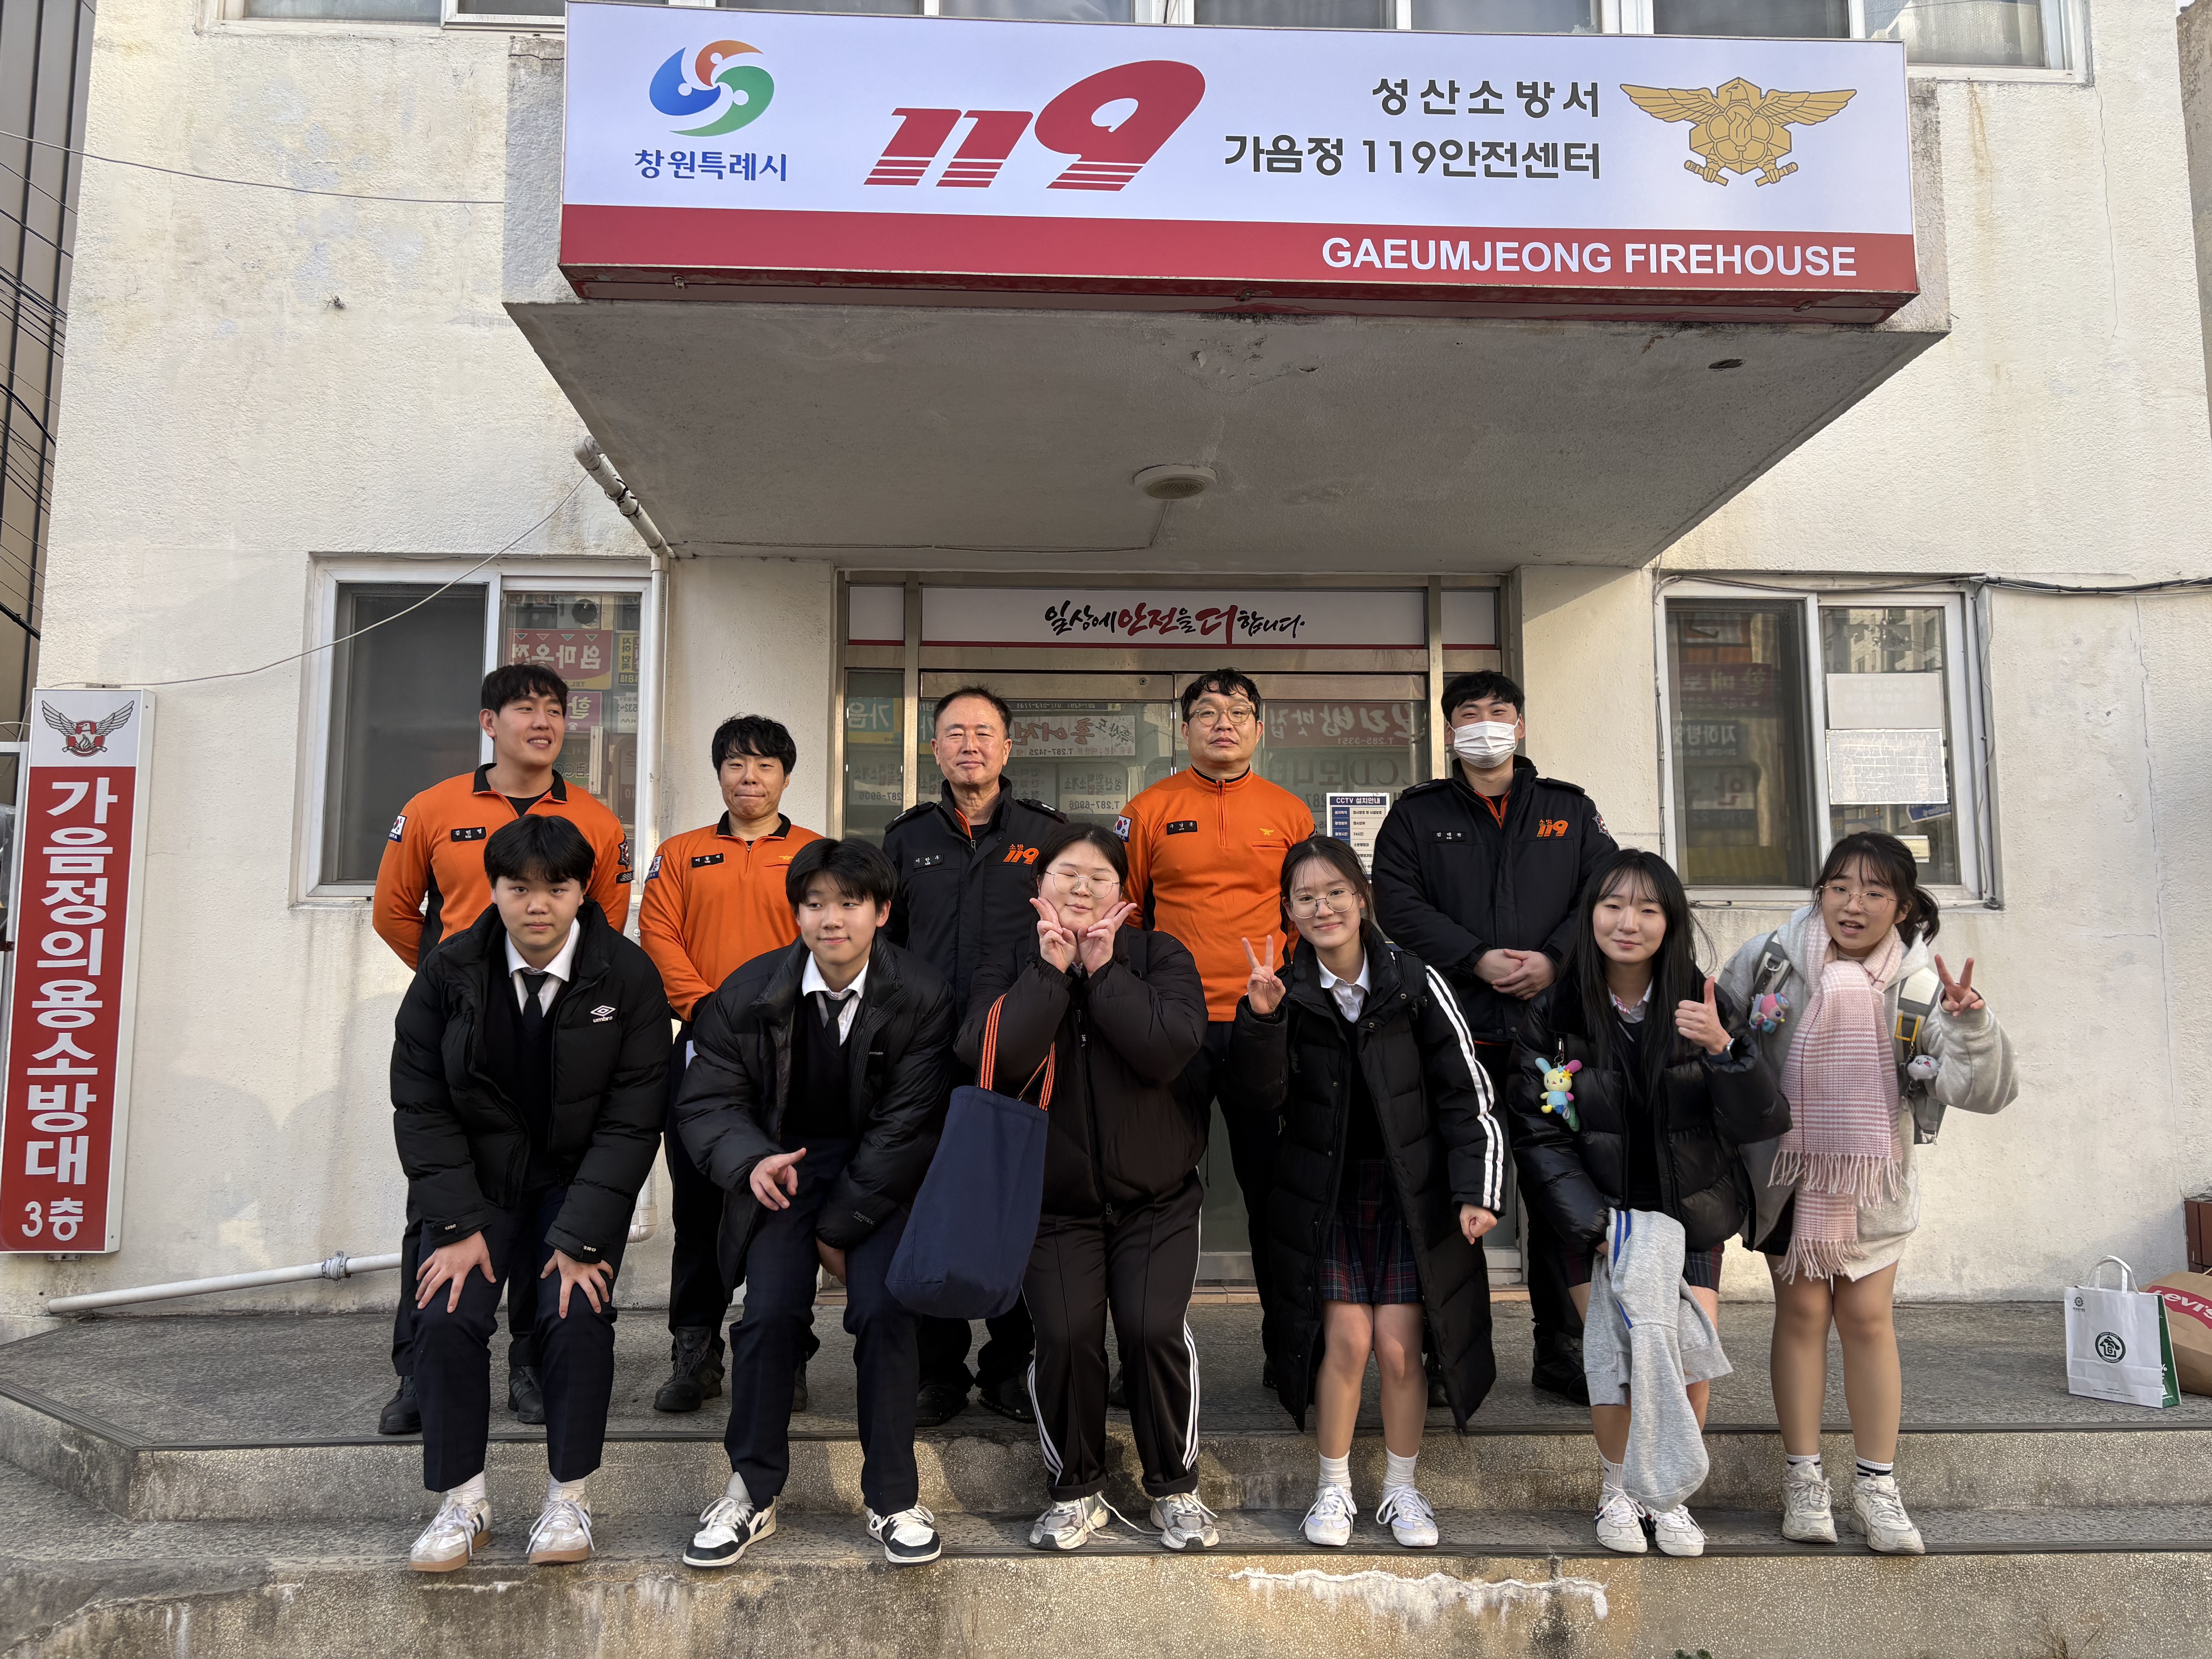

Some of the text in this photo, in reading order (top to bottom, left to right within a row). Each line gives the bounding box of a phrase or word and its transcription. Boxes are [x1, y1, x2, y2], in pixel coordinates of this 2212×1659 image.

[1372, 78, 1599, 118] 성산소방서
[863, 60, 1206, 191] 119
[635, 149, 786, 181] 창원특례시
[1224, 134, 1600, 179] 가음정 119안전센터
[1322, 237, 1857, 276] GAEUMJEONG FIREHOUSE
[1045, 600, 1117, 636] 일상에
[1118, 602, 1196, 636] 안전을
[1536, 820, 1569, 837] 119
[1003, 848, 1040, 865] 119
[25, 776, 118, 1185] 가음정의용소방대
